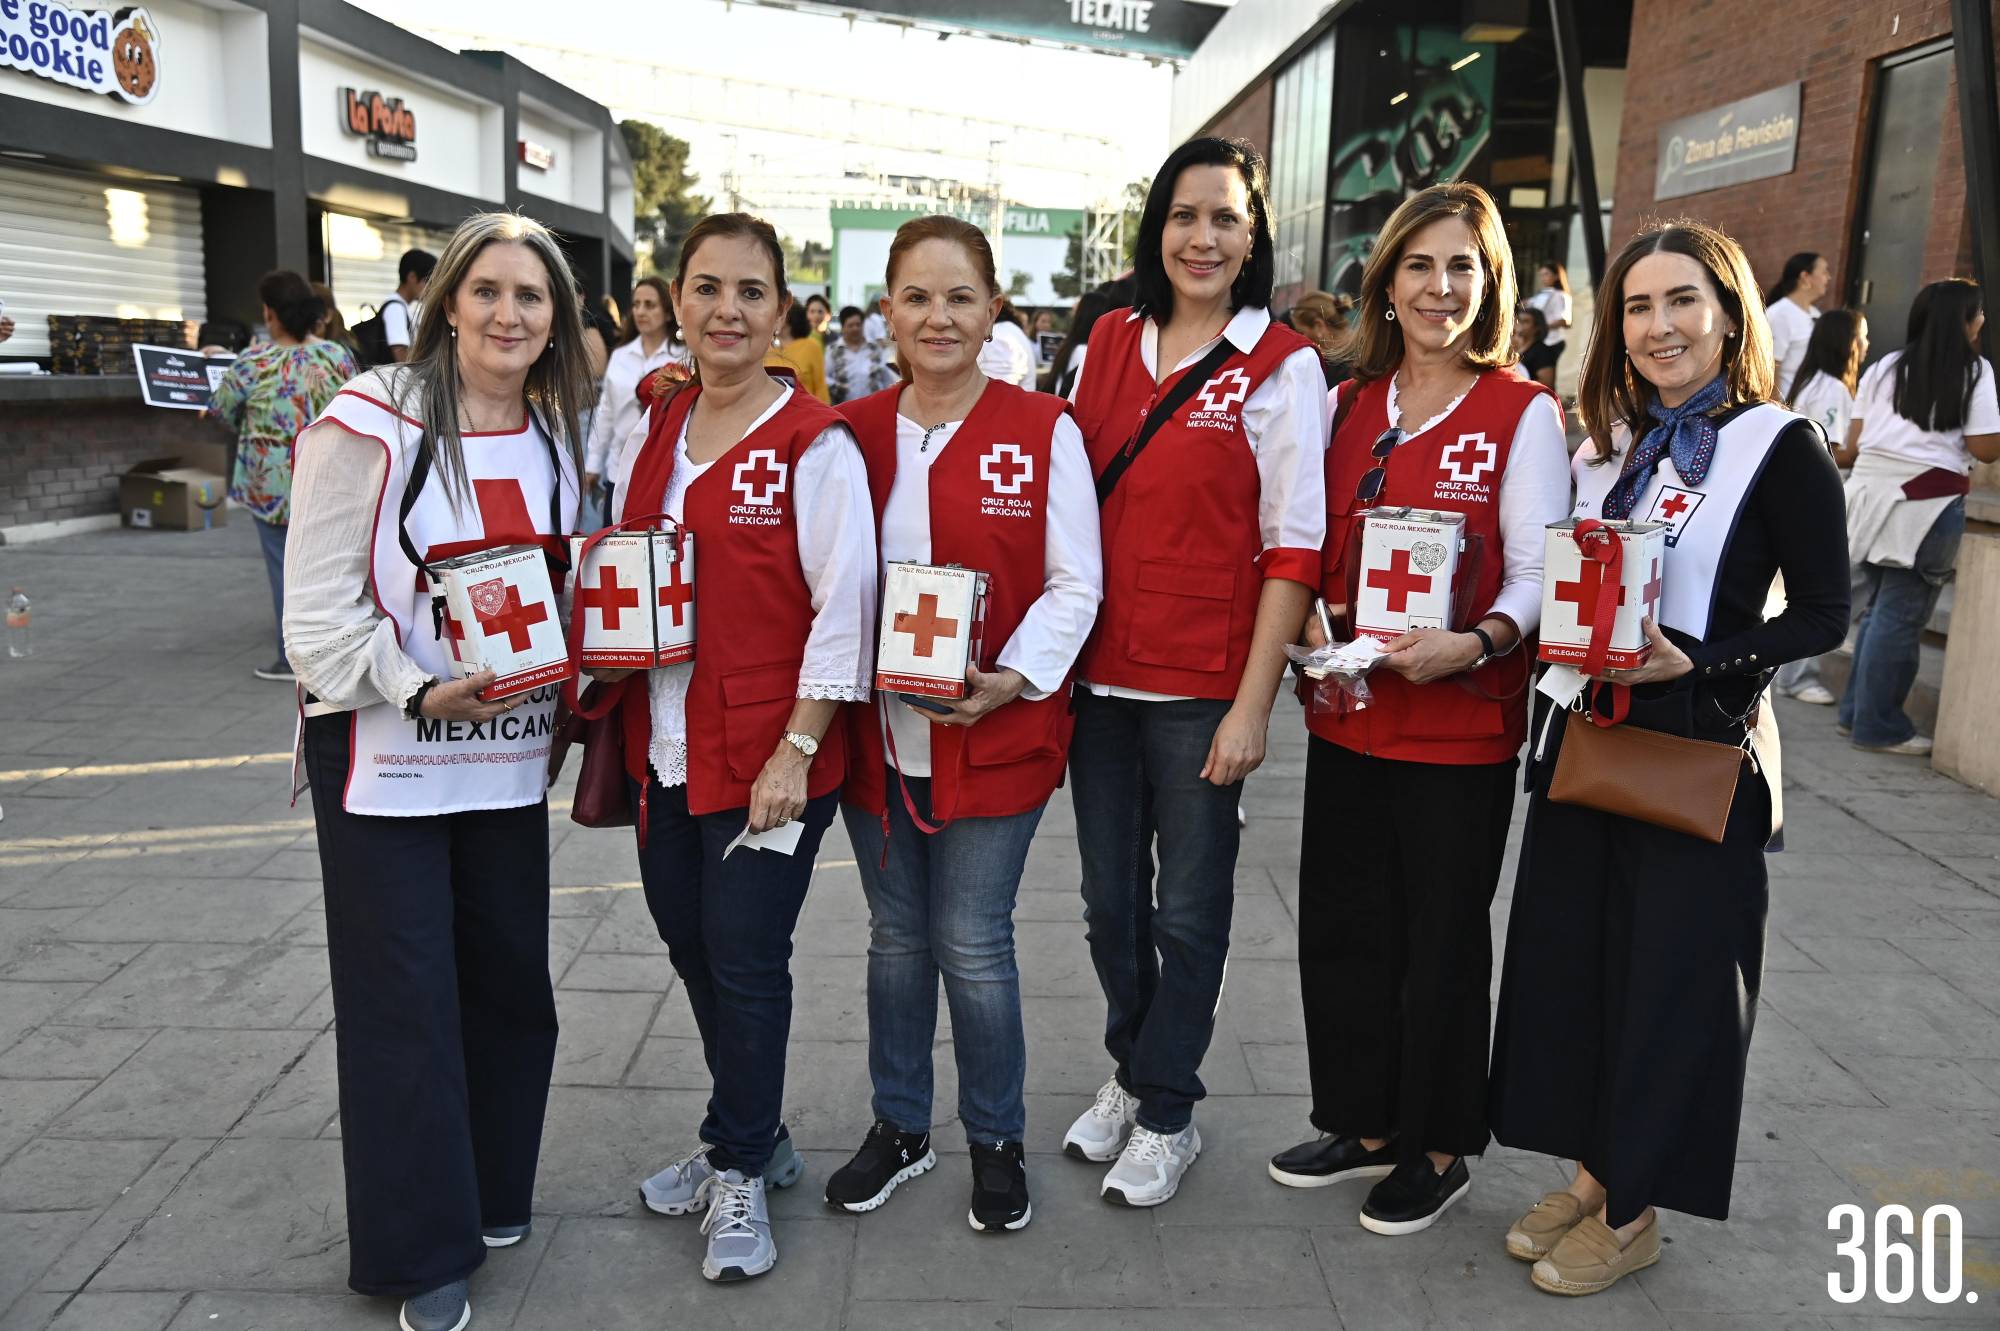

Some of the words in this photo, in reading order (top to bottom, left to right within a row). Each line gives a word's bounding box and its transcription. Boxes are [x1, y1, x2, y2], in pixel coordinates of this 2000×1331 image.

[1065, 0, 1155, 33] TECATE
[29, 3, 109, 50] good
[1684, 139, 1716, 164] Zona
[1716, 131, 1734, 156] de
[1189, 411, 1212, 420] CRUZ
[1212, 412, 1237, 424] ROJA
[1186, 420, 1234, 432] MEXICANA
[1435, 481, 1463, 490] CRUZ
[1465, 483, 1490, 494] ROJA
[981, 497, 1005, 506] CRUZ
[1007, 499, 1032, 508] ROJA
[1433, 490, 1488, 503] MEXICANA
[729, 505, 757, 515] CRUZ
[759, 506, 782, 516] ROJA
[981, 506, 1031, 518] MEXICANA
[729, 515, 781, 526] MEXICANA
[1407, 525, 1441, 535] MEXICANA
[465, 564, 484, 576] CRUZ
[485, 561, 503, 572] ROJA
[503, 553, 536, 569] MEXICANA
[897, 566, 914, 574] CRUZ
[933, 570, 966, 578] MEXICANA
[1548, 648, 1587, 658] DELEGACIO
[493, 674, 535, 692] DELEGACION
[535, 666, 564, 681] SALTILLO
[884, 677, 925, 687] DELEGACION
[926, 681, 955, 691] SALTILLO
[378, 771, 412, 779] ASOCIADO
[413, 771, 424, 779] No.
